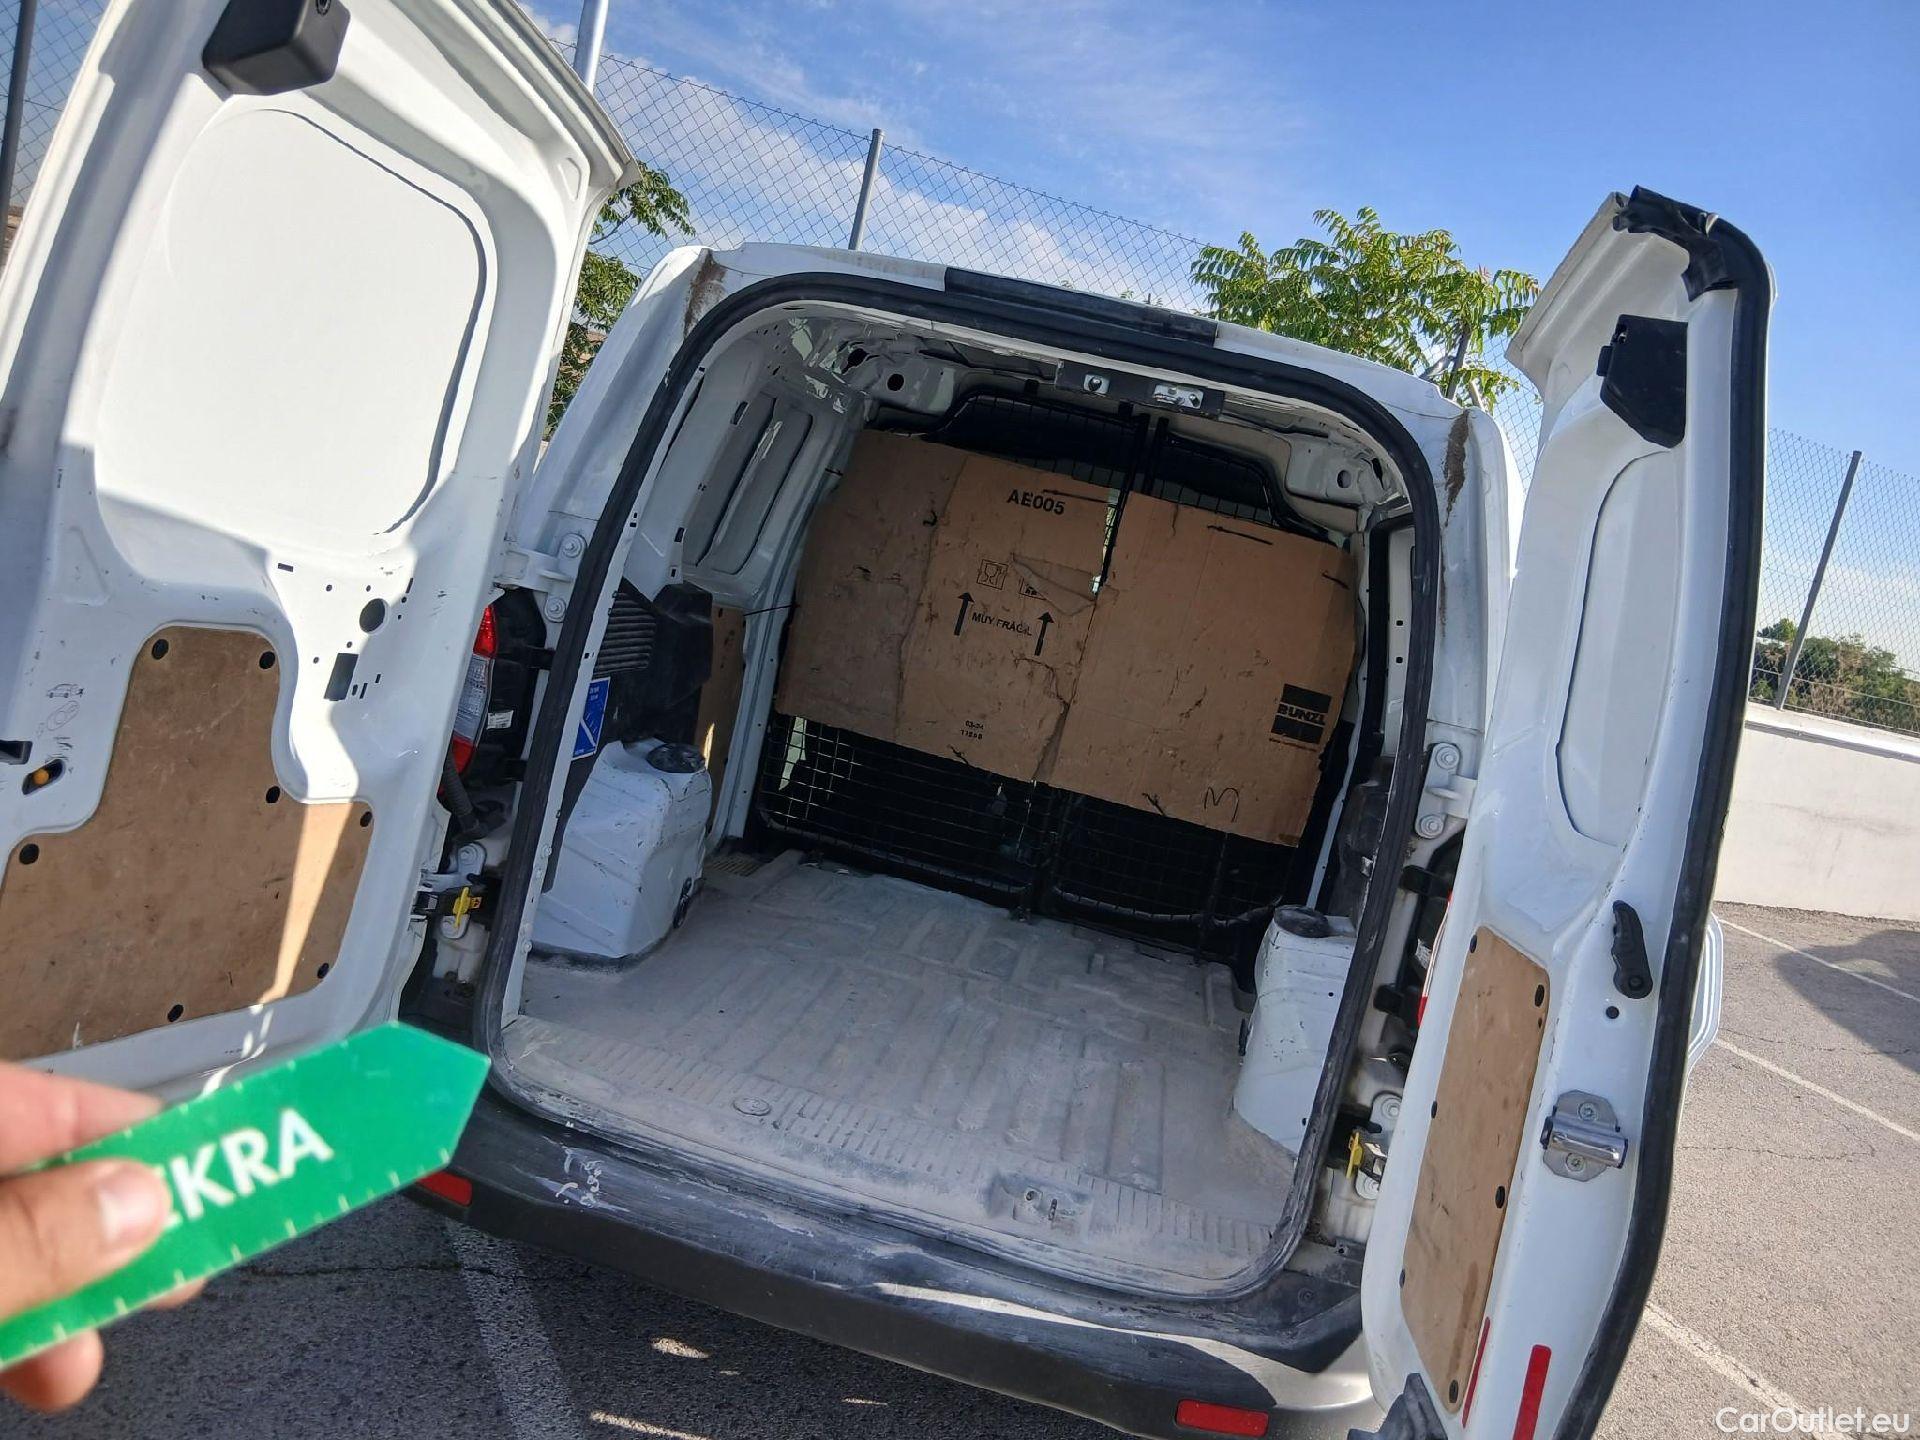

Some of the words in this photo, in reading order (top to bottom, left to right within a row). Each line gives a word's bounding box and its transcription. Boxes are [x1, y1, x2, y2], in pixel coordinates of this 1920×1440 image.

[1006, 489, 1066, 515] AE005
[971, 612, 995, 624] MUY
[1277, 703, 1326, 726] BUNZL
[153, 1107, 335, 1233] KRA
